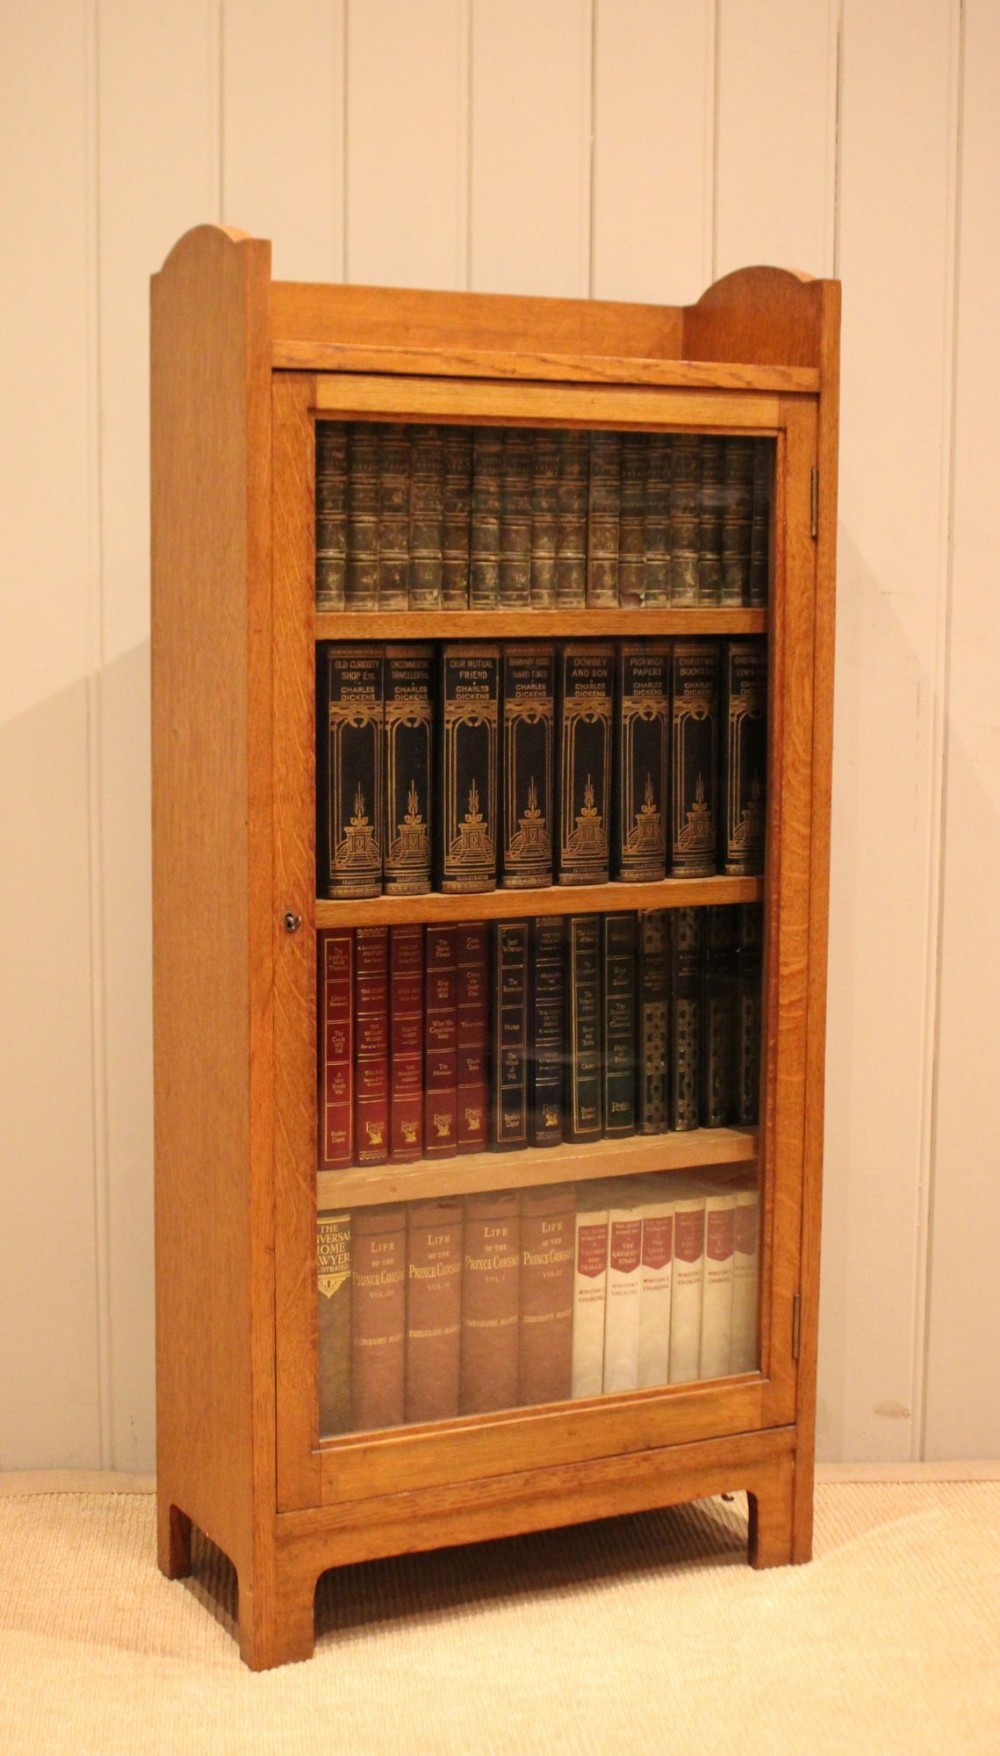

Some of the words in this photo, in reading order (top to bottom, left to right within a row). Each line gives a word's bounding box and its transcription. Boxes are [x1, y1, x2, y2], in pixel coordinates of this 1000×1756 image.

[335, 660, 348, 669] OLD
[349, 660, 380, 669] CURIOSITY
[449, 660, 467, 668] OUR
[467, 660, 492, 668] MUTUAL
[341, 671, 361, 680] SHOP
[459, 670, 488, 680] FRIEND
[572, 668, 590, 677] AND
[591, 668, 608, 677] SON
[632, 667, 662, 676] PAPERS
[456, 685, 490, 693] CHARLES
[515, 683, 546, 691] CHARLES
[340, 693, 375, 701] DICKENS
[394, 693, 428, 701] DICKENS
[321, 1224, 339, 1233] THE
[484, 1226, 509, 1238] LIFE
[541, 1222, 563, 1233] LIFE
[427, 1234, 451, 1246] LIFE
[541, 1239, 550, 1247] OF
[550, 1237, 563, 1245] THE
[371, 1242, 395, 1253] LIFE
[494, 1243, 507, 1251] THE
[317, 1252, 351, 1266] WYER
[427, 1252, 437, 1260] OF
